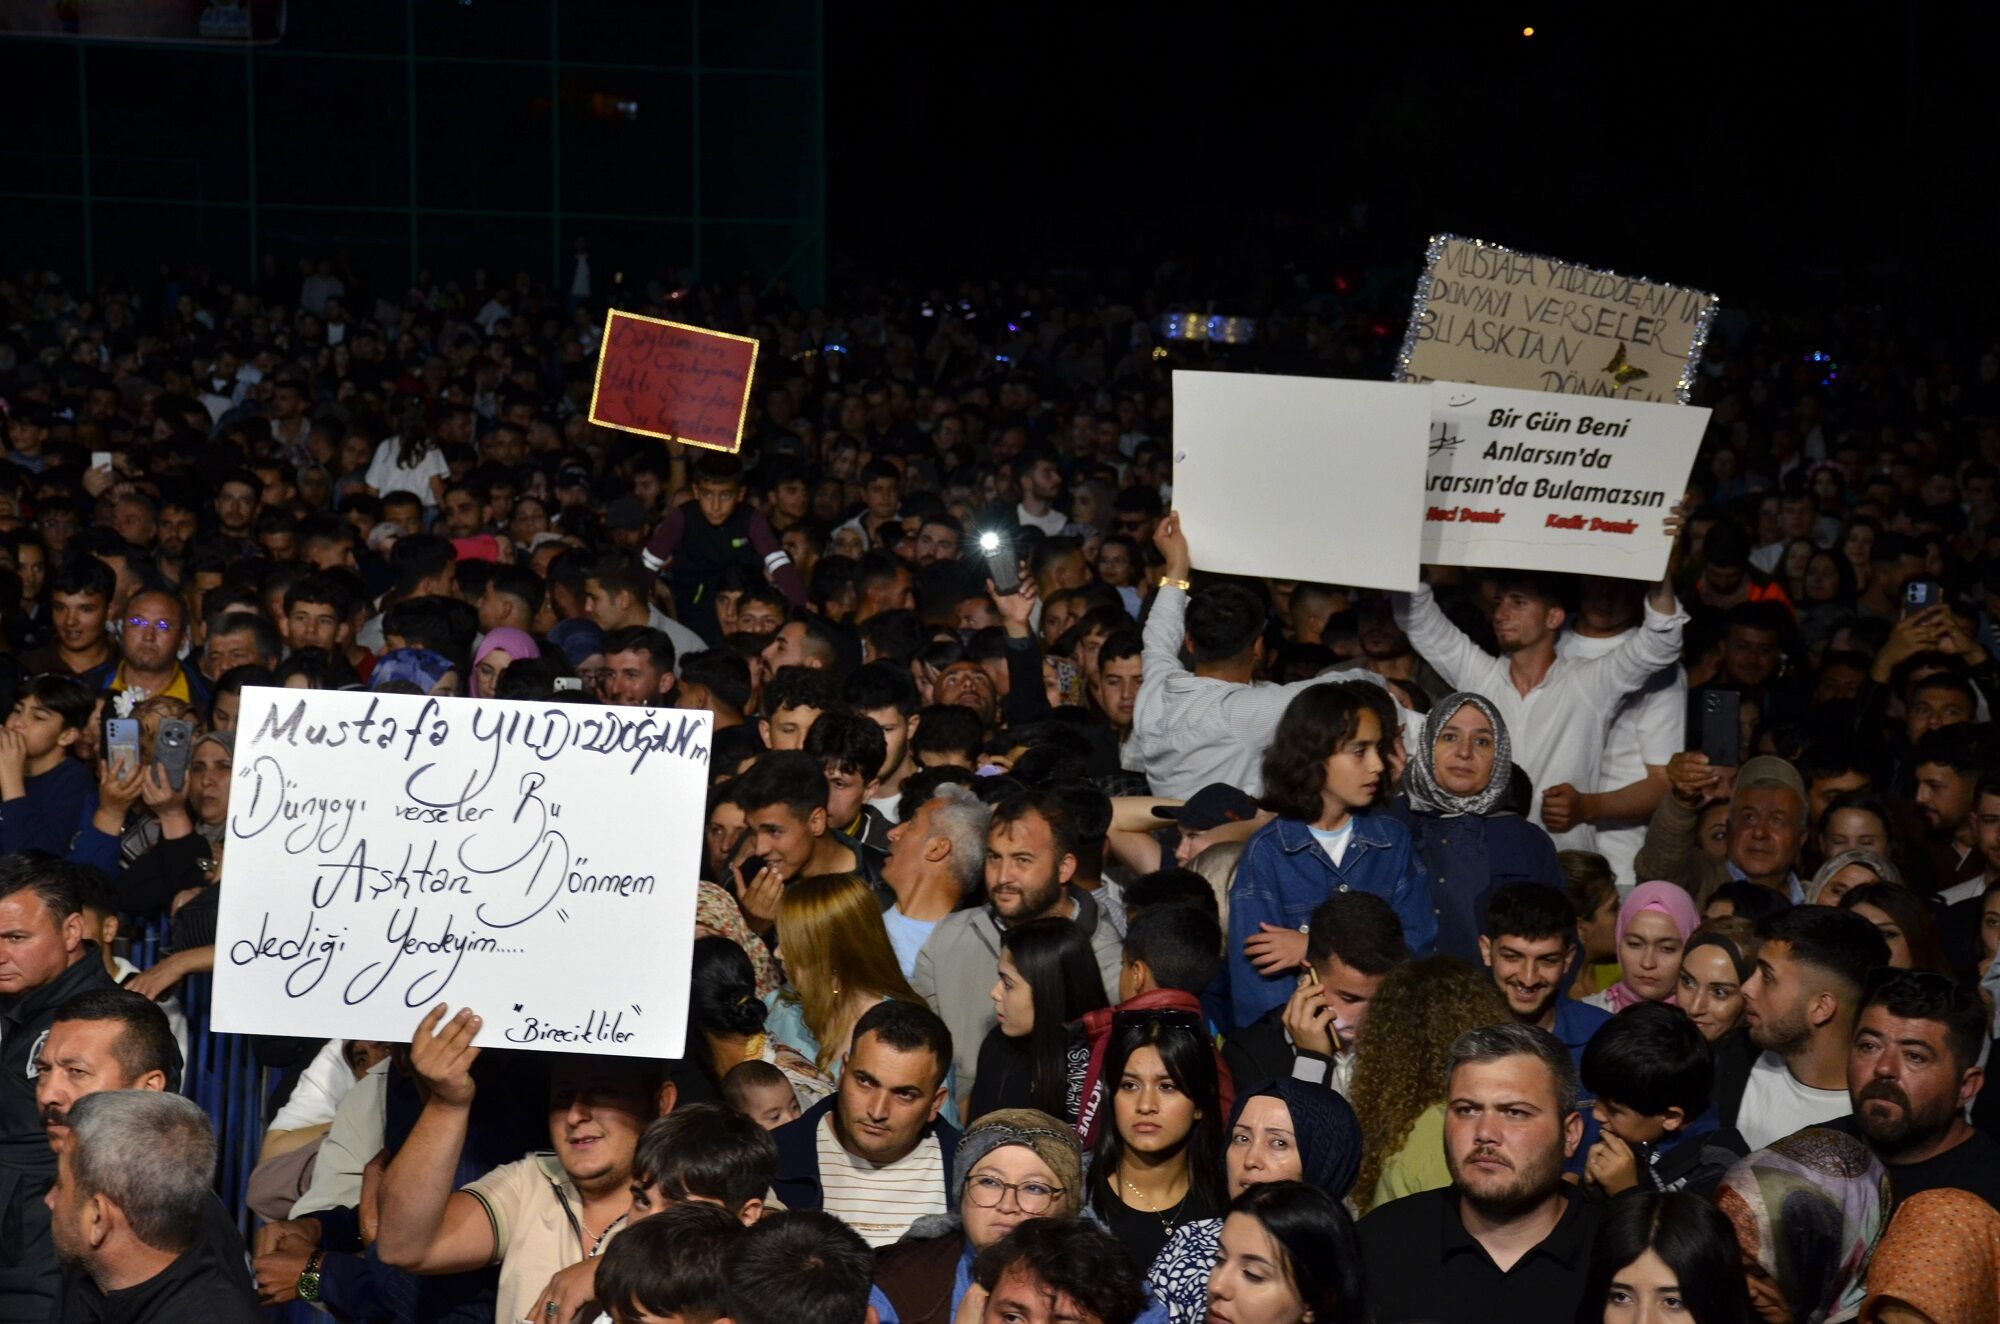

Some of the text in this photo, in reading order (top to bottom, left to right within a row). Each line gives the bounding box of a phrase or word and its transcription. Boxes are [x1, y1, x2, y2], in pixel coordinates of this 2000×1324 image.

[1525, 295, 1688, 360] VERSELER
[1487, 407, 1632, 438] Bir Gün Beni
[1482, 440, 1613, 469] Anlarsın'da
[1532, 478, 1666, 508] Bulamazsın
[249, 696, 450, 762] Mustafa
[230, 910, 349, 999] dediği
